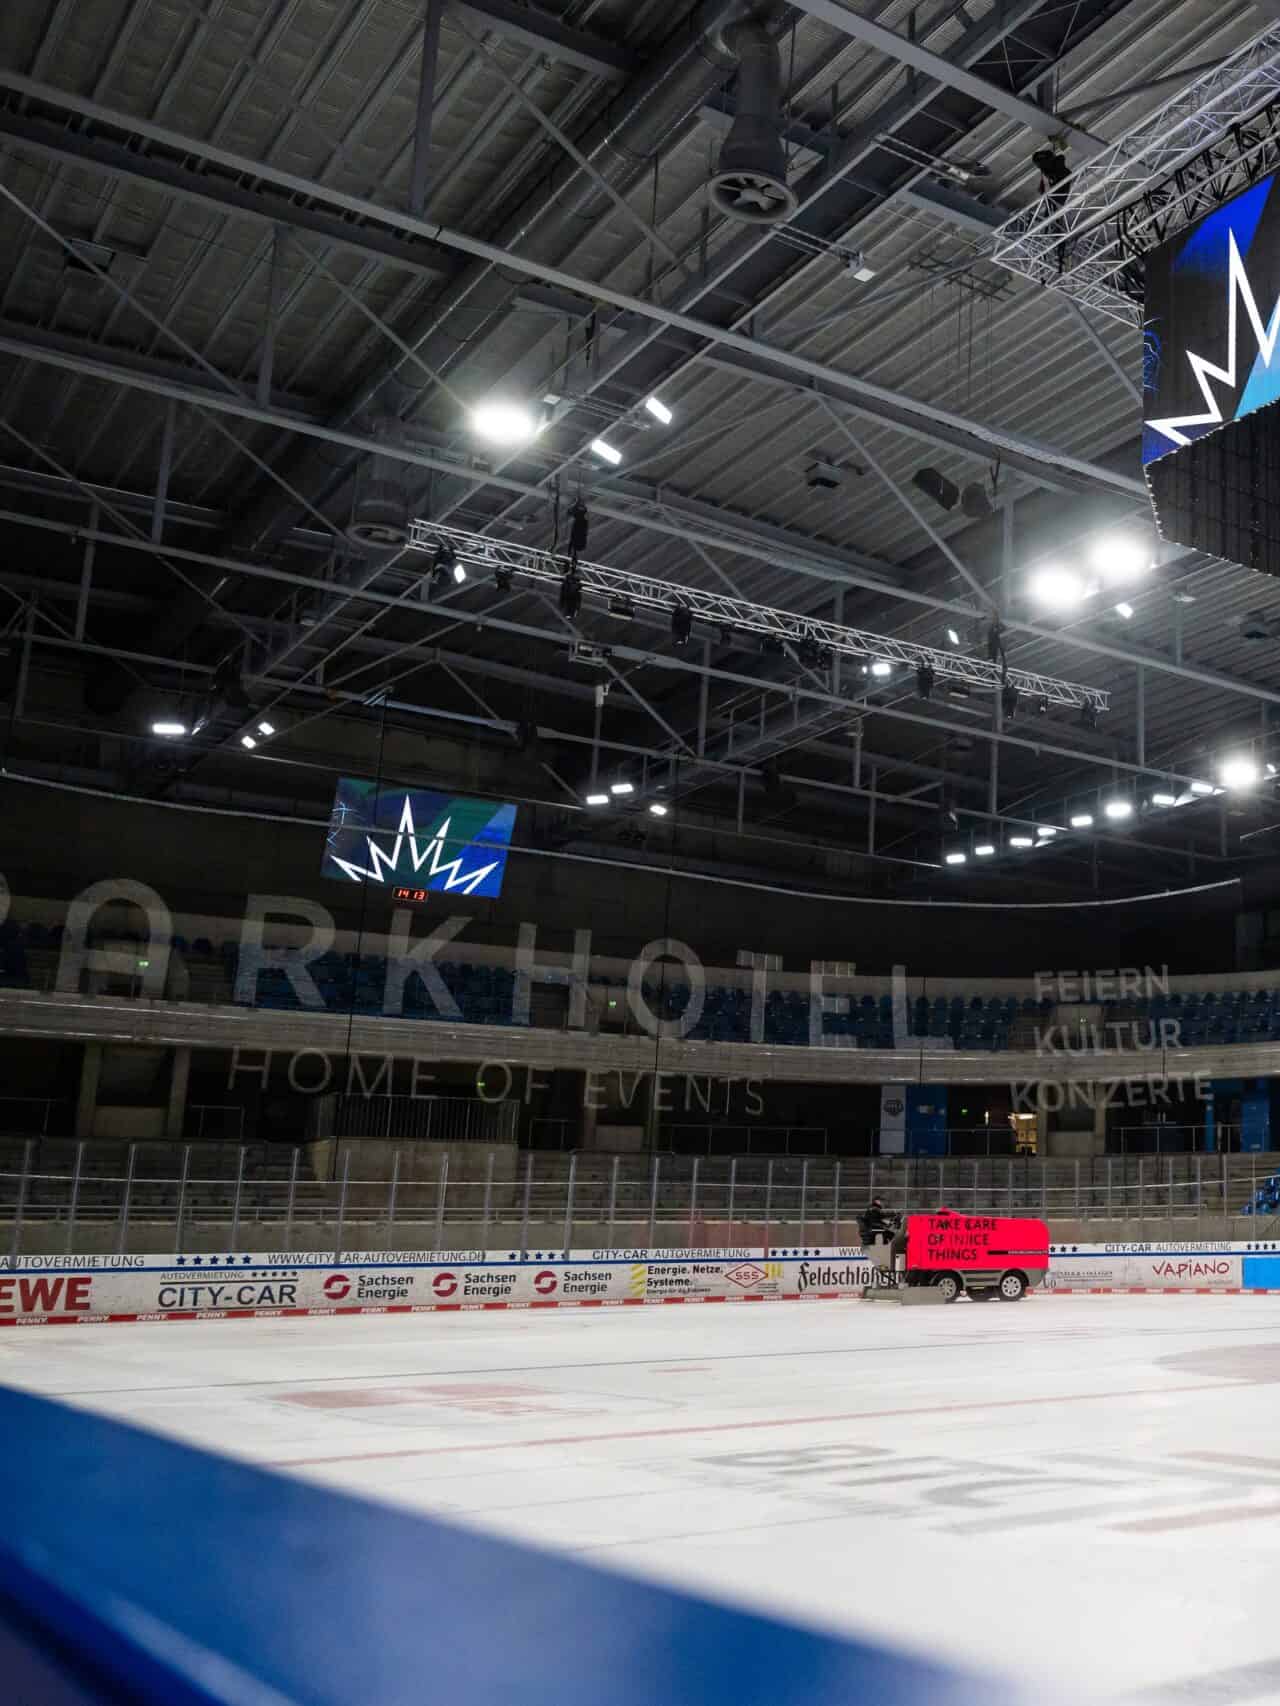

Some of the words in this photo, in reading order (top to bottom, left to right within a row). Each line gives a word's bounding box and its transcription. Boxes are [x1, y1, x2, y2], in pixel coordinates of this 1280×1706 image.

[0, 873, 955, 1051] ARKHOTEL
[1034, 964, 1169, 1002] FEIERN
[1034, 1018, 1183, 1058] KULTUR
[227, 1044, 438, 1100] HOME
[476, 1060, 555, 1105] OF
[583, 1069, 766, 1116] EVENTS
[1010, 1069, 1214, 1113] KONZERTE
[928, 1218, 960, 1230] TAKE
[965, 1218, 998, 1231] CARE
[928, 1233, 944, 1246] OF
[592, 1249, 648, 1260] CITY-CAR
[655, 1248, 750, 1258] AUTOVERMIETUNG
[928, 1248, 977, 1262] THINGS
[357, 1275, 414, 1286] Sachsen
[464, 1272, 517, 1284] Sachsen
[563, 1271, 612, 1282] Sachsen
[357, 1287, 409, 1300] Energie
[464, 1285, 512, 1297] Energie
[563, 1283, 608, 1295] Energie
[158, 1284, 296, 1308] CITY-CAR
